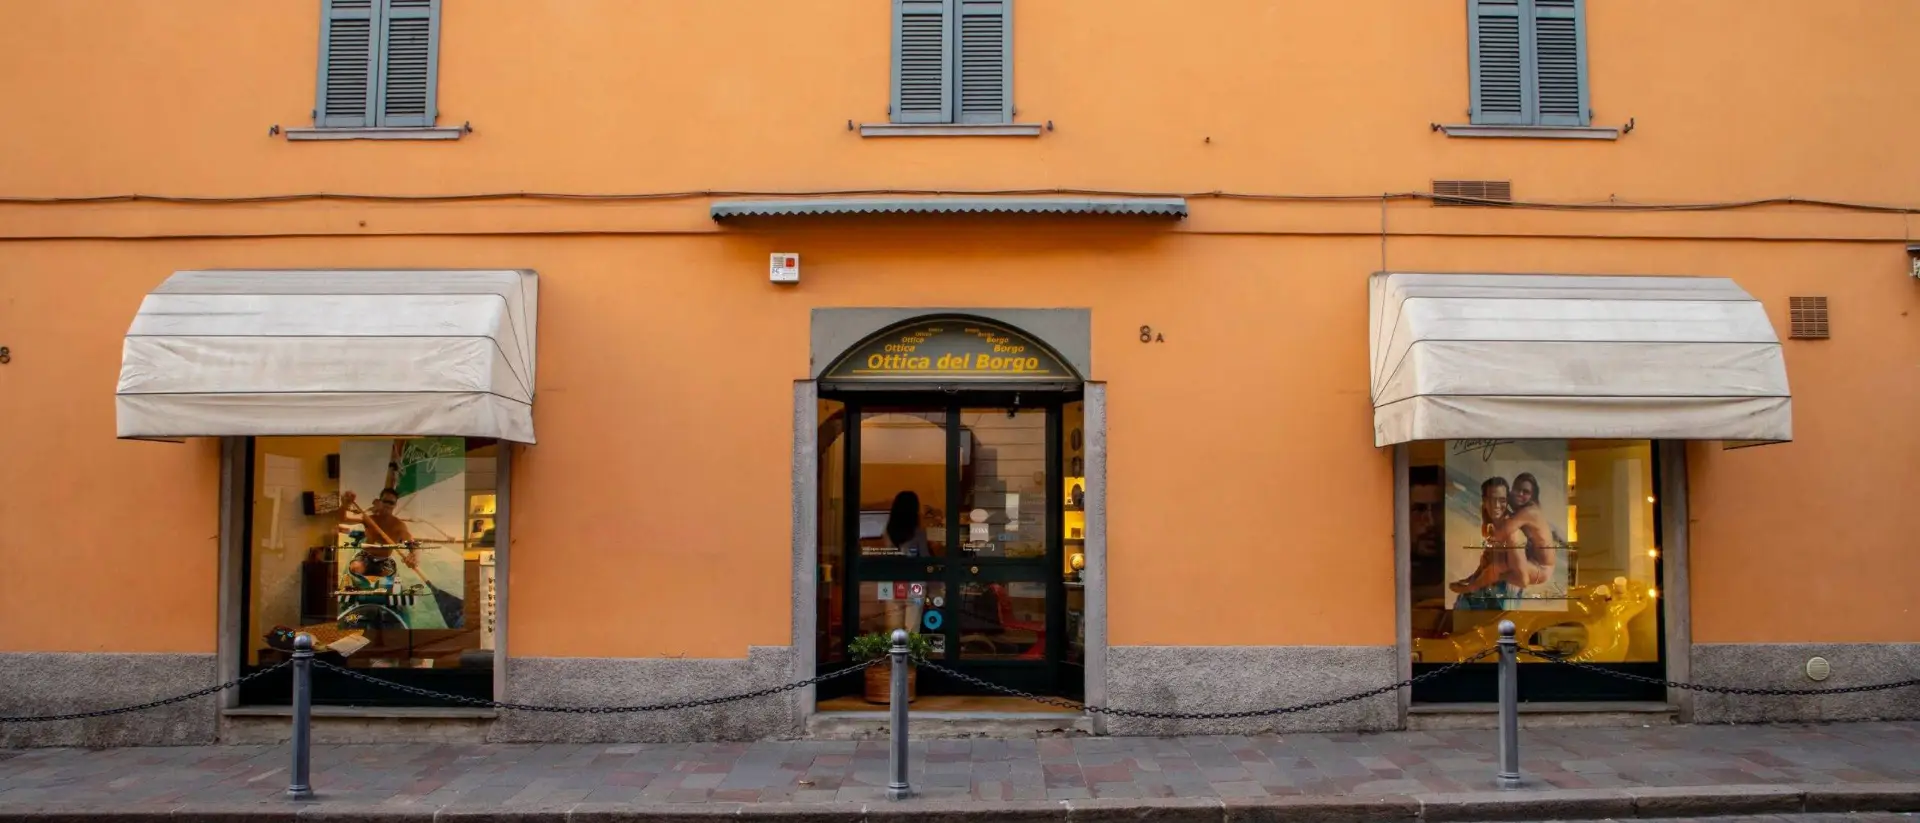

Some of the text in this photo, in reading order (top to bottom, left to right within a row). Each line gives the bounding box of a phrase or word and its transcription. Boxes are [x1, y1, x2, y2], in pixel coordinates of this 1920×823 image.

[902, 336, 1009, 344] Ottica Borgo
[884, 343, 1025, 354] Ottica Borgo
[867, 352, 1039, 374] Ottica del Borgo
